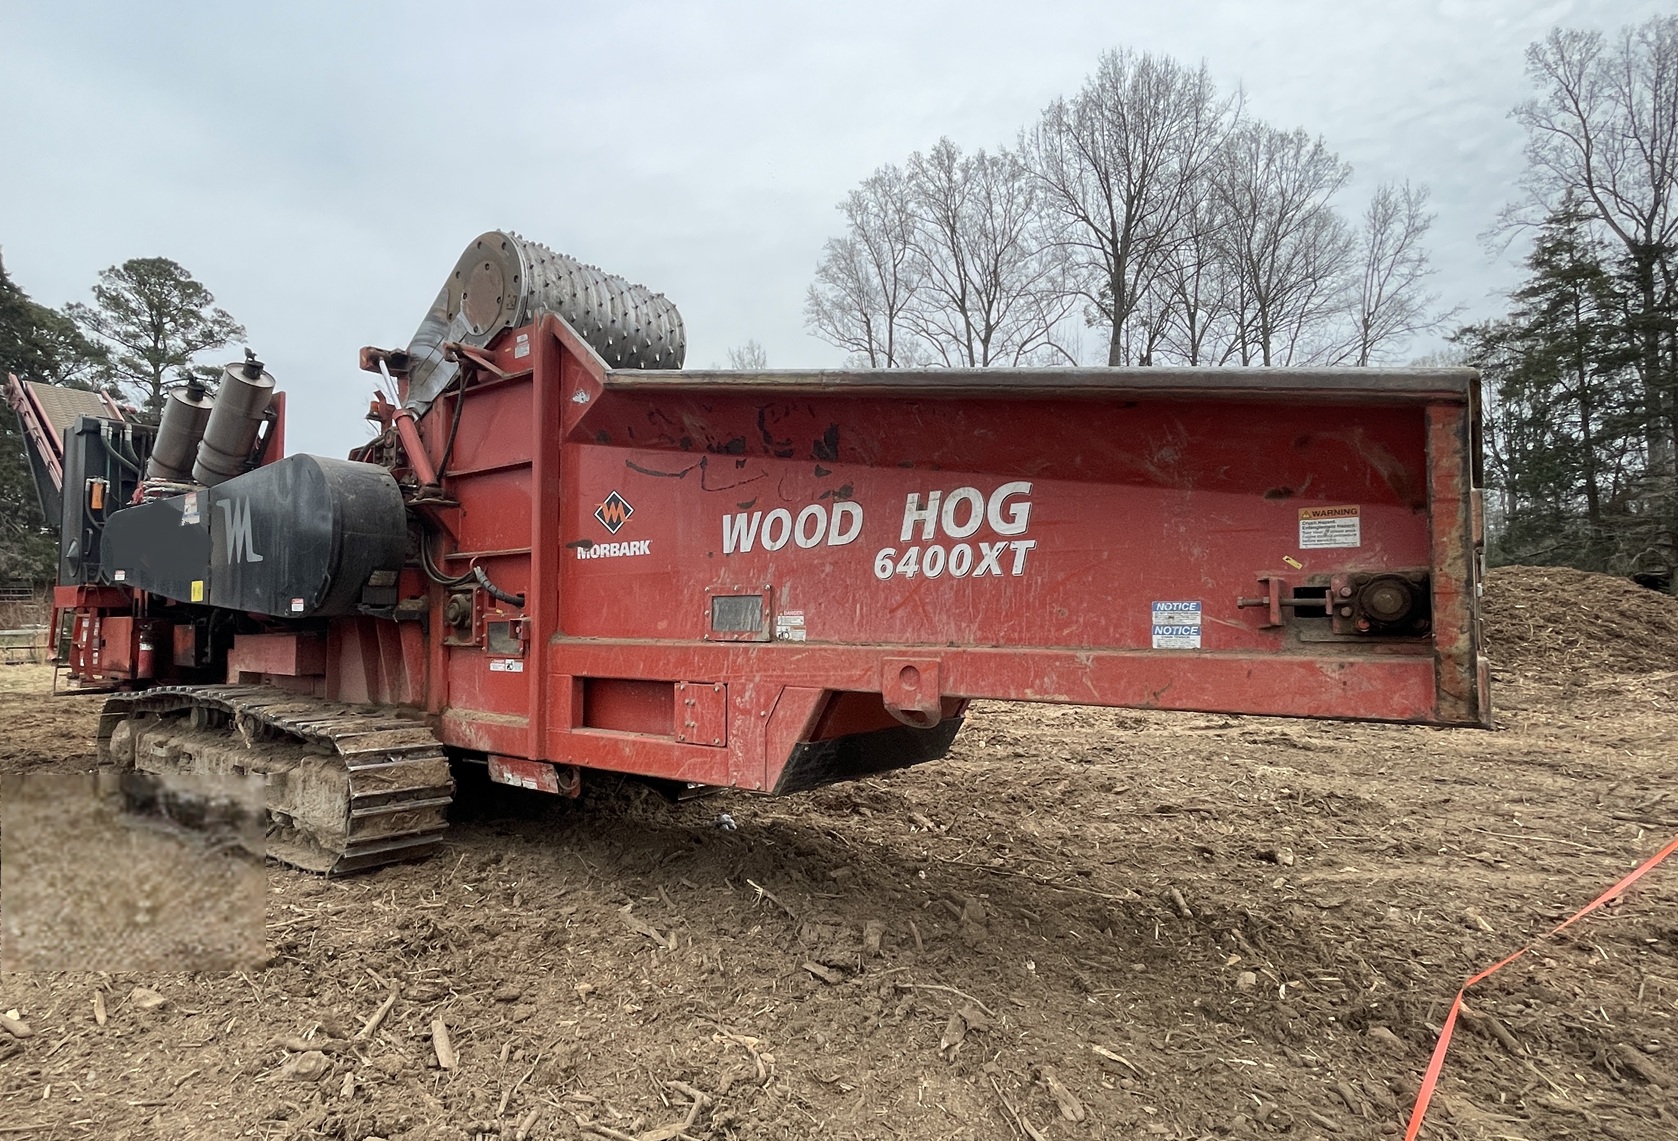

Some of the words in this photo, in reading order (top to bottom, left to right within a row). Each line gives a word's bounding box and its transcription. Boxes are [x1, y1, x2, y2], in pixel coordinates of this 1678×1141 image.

[722, 501, 864, 554] WOOD
[900, 481, 1033, 542] HOG
[1312, 508, 1357, 517] WARNING
[577, 540, 651, 560] MORBARK
[873, 540, 1037, 580] 6400XT
[1156, 602, 1197, 610] NOTICE
[1154, 626, 1199, 635] NOTICE
